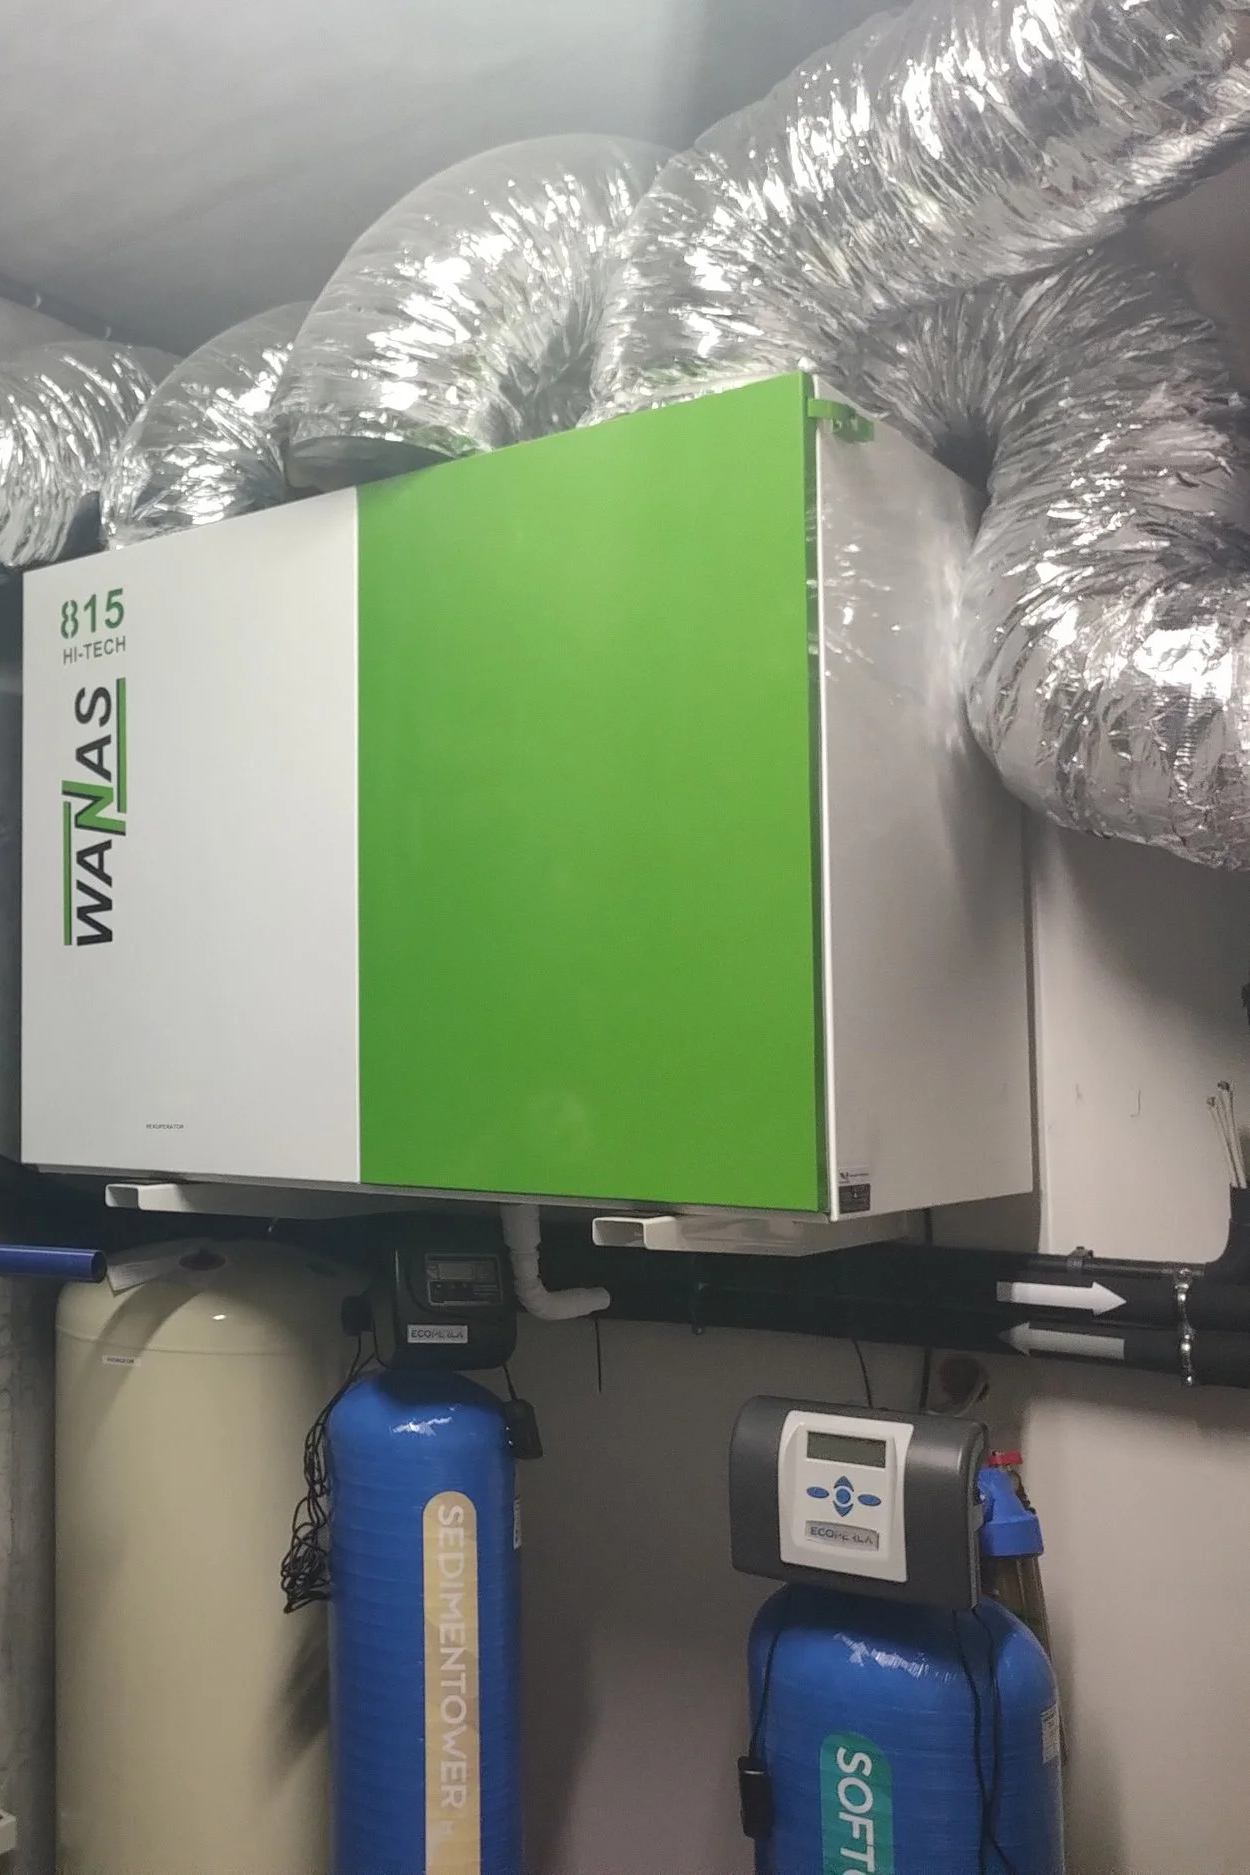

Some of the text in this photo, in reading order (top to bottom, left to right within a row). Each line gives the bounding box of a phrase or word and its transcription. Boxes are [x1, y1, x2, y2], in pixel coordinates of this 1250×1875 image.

[60, 587, 125, 639] 815
[62, 635, 127, 665] HI-TECH
[61, 685, 127, 947] WANAS
[438, 1504, 468, 1809] SEDIMENTOWER
[836, 1746, 875, 1875] SOFT
